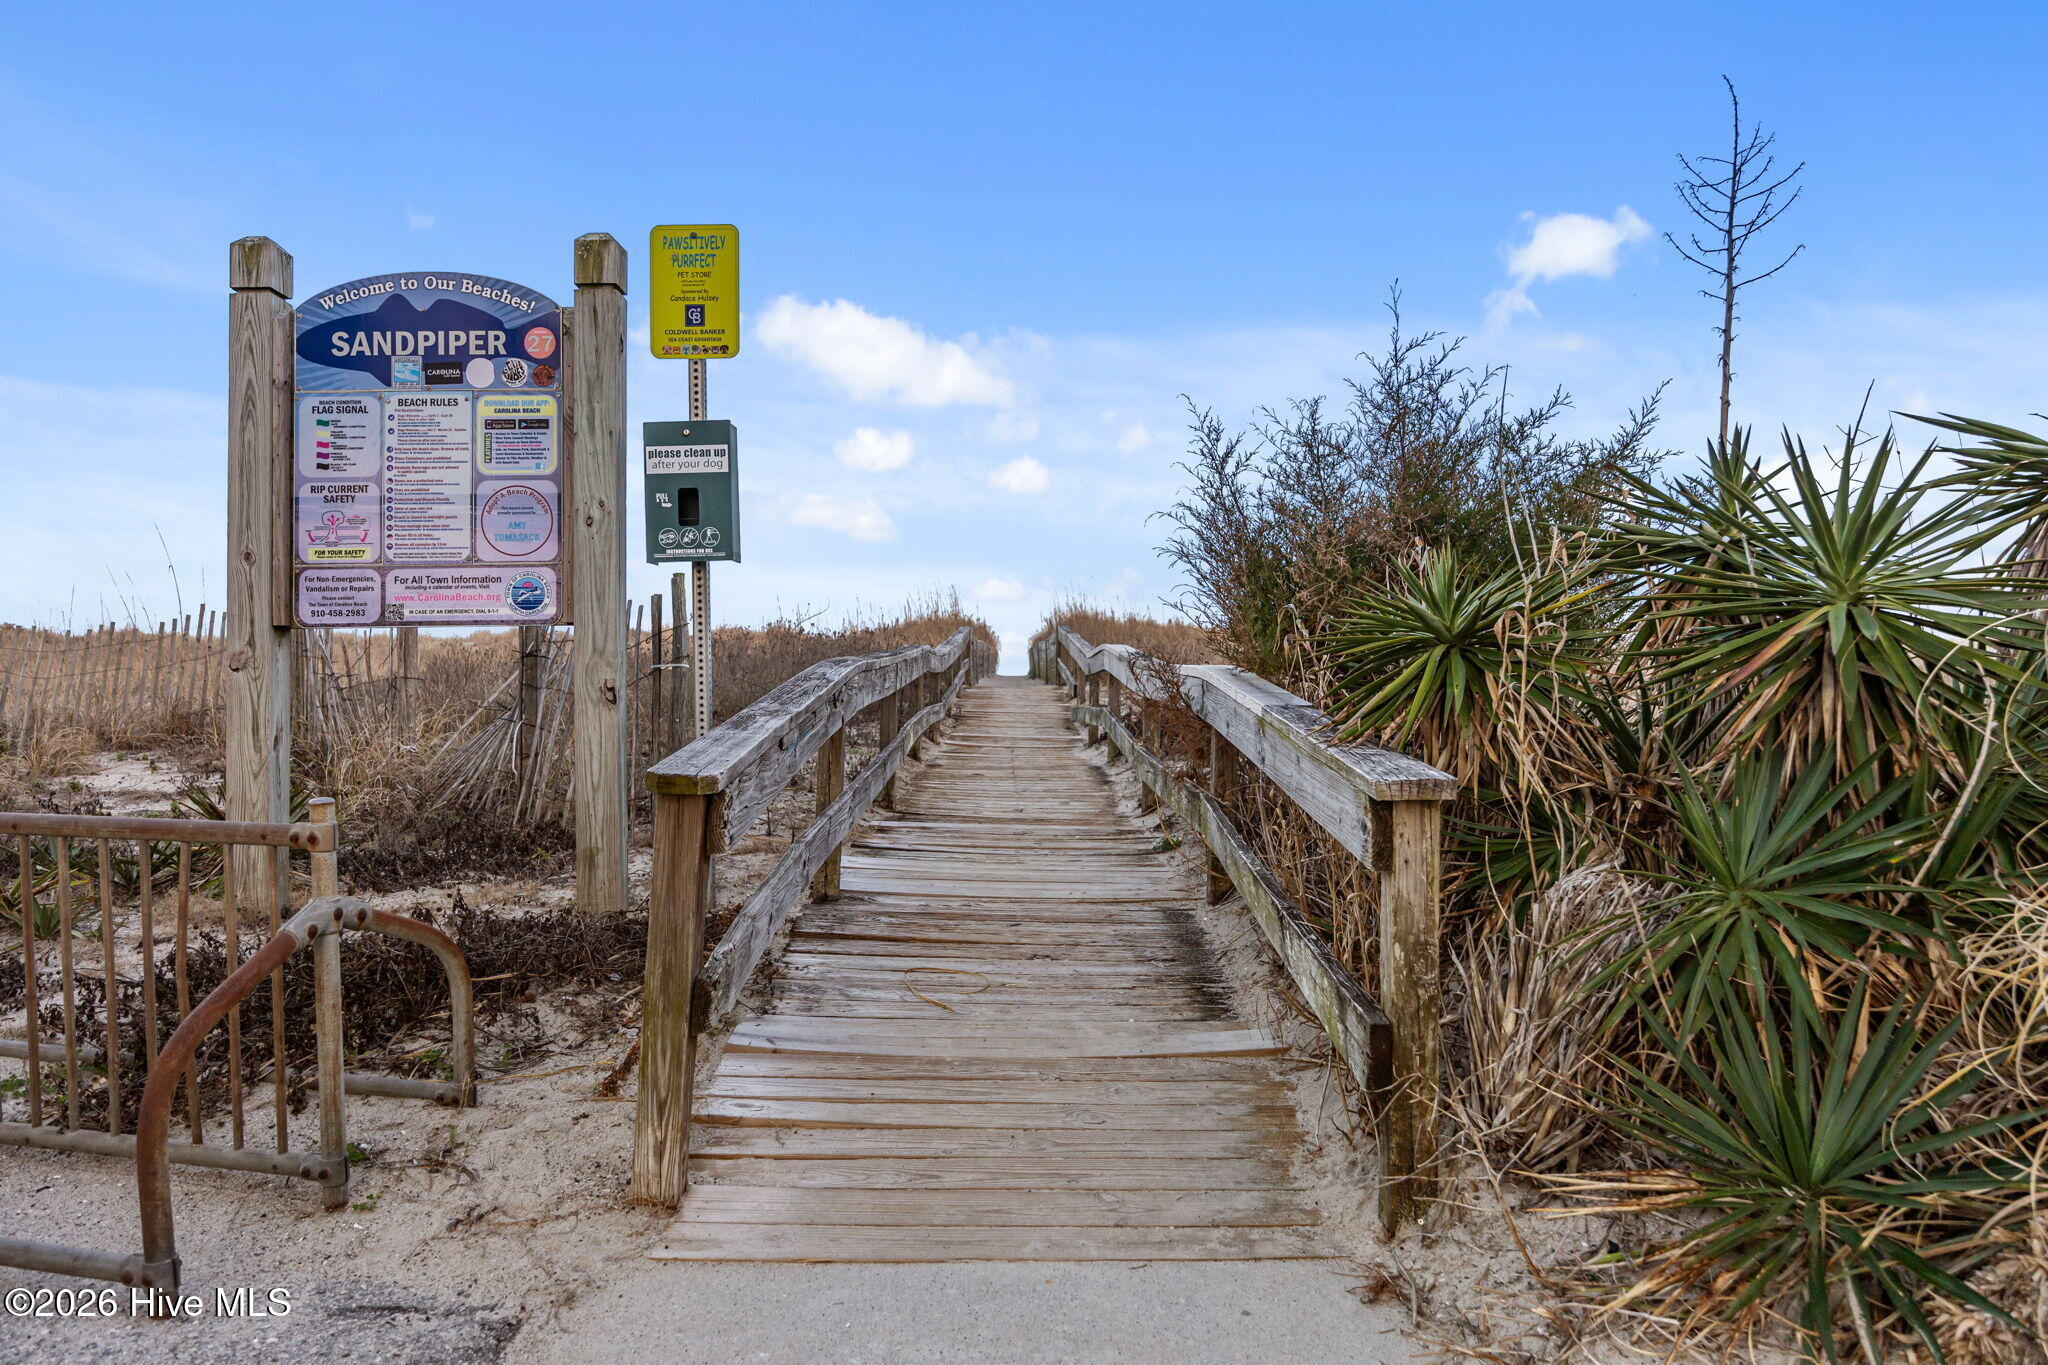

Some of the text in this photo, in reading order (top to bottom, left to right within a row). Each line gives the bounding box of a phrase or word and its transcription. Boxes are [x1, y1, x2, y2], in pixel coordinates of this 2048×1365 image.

[662, 235, 726, 250] PAWSITIVELY
[672, 253, 717, 268] PURRFECT
[318, 276, 536, 314] Welcome to Our Beaches!
[698, 295, 719, 303] Hulsey
[331, 330, 553, 357] SANDPIPER 27
[398, 398, 459, 407] BEACH RULES
[312, 405, 369, 414] FLAG SIGNAL
[648, 448, 726, 459] please clean up
[652, 459, 723, 470] after your dog
[310, 485, 369, 494] RIP CURRENT
[323, 495, 356, 504] SAFETY
[529, 492, 549, 515] Program
[508, 521, 527, 529] AMY
[494, 533, 540, 541] TOMASACK
[394, 575, 502, 584] For All Town Information
[519, 572, 544, 582] CAROLINA
[349, 585, 375, 593] Repairs
[394, 593, 501, 603] www.CarolinaBeach.org
[310, 609, 366, 618] 910-458-2983
